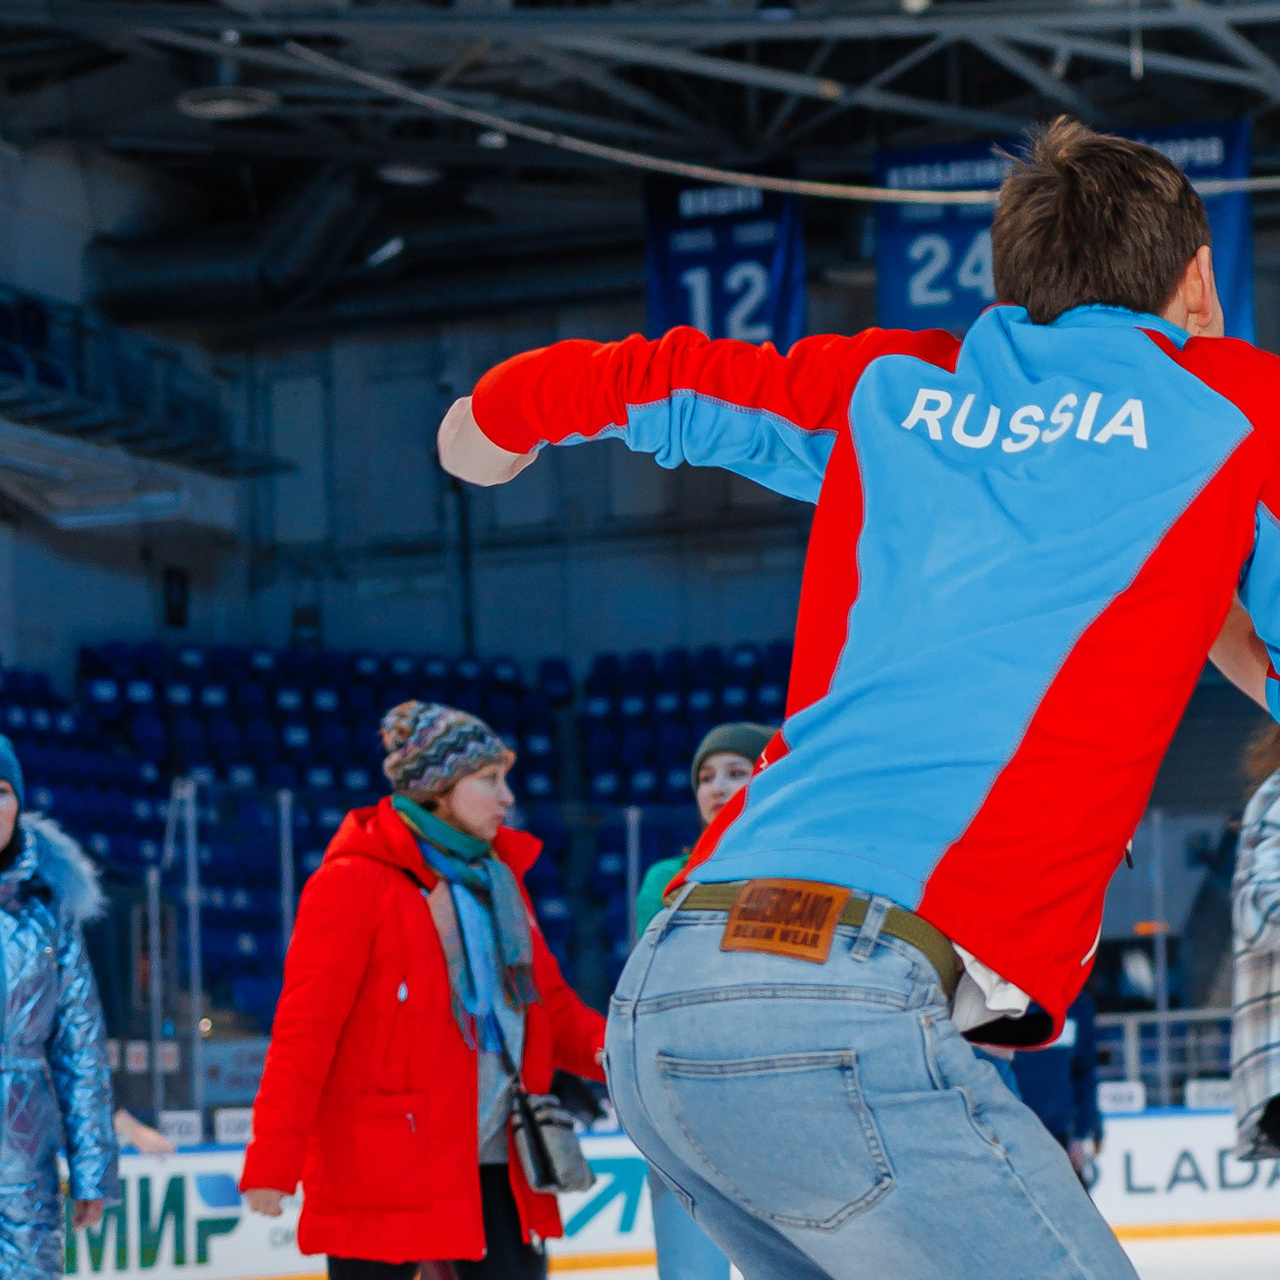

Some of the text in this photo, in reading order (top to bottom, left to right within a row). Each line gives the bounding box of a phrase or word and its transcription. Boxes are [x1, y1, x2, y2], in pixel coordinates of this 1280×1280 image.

[681, 260, 773, 341] 12
[908, 228, 996, 305] 24
[900, 387, 1148, 455] RUSSIA
